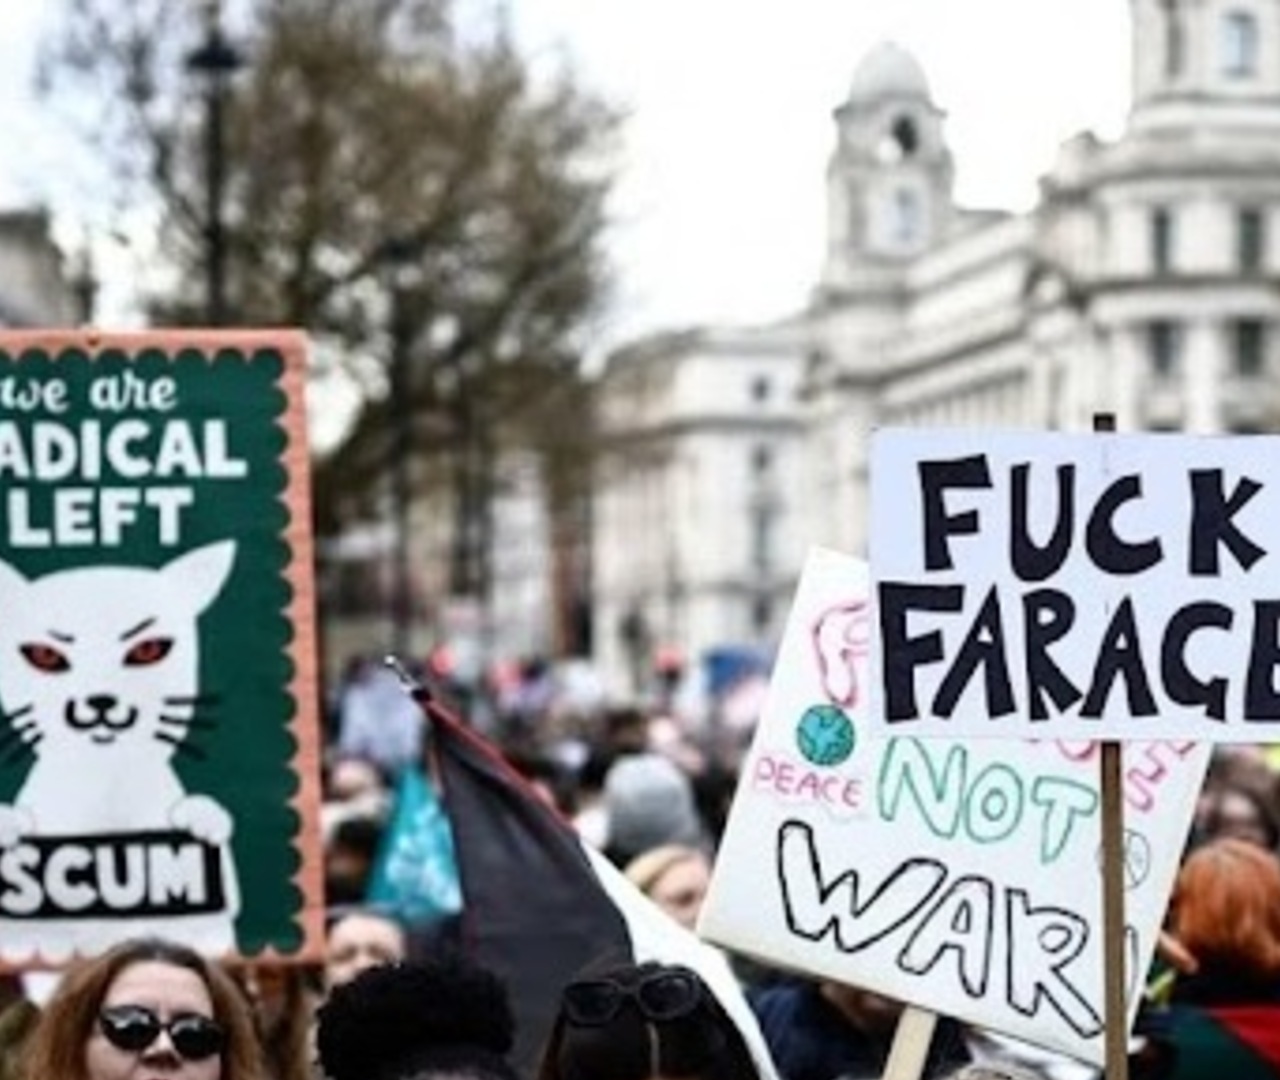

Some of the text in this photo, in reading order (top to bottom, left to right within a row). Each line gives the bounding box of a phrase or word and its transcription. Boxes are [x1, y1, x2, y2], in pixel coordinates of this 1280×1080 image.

[88, 368, 178, 412] are
[7, 485, 195, 547] LEFT
[917, 453, 1269, 583] FUCK
[753, 756, 864, 807] PEACE
[877, 736, 1100, 864] NOT
